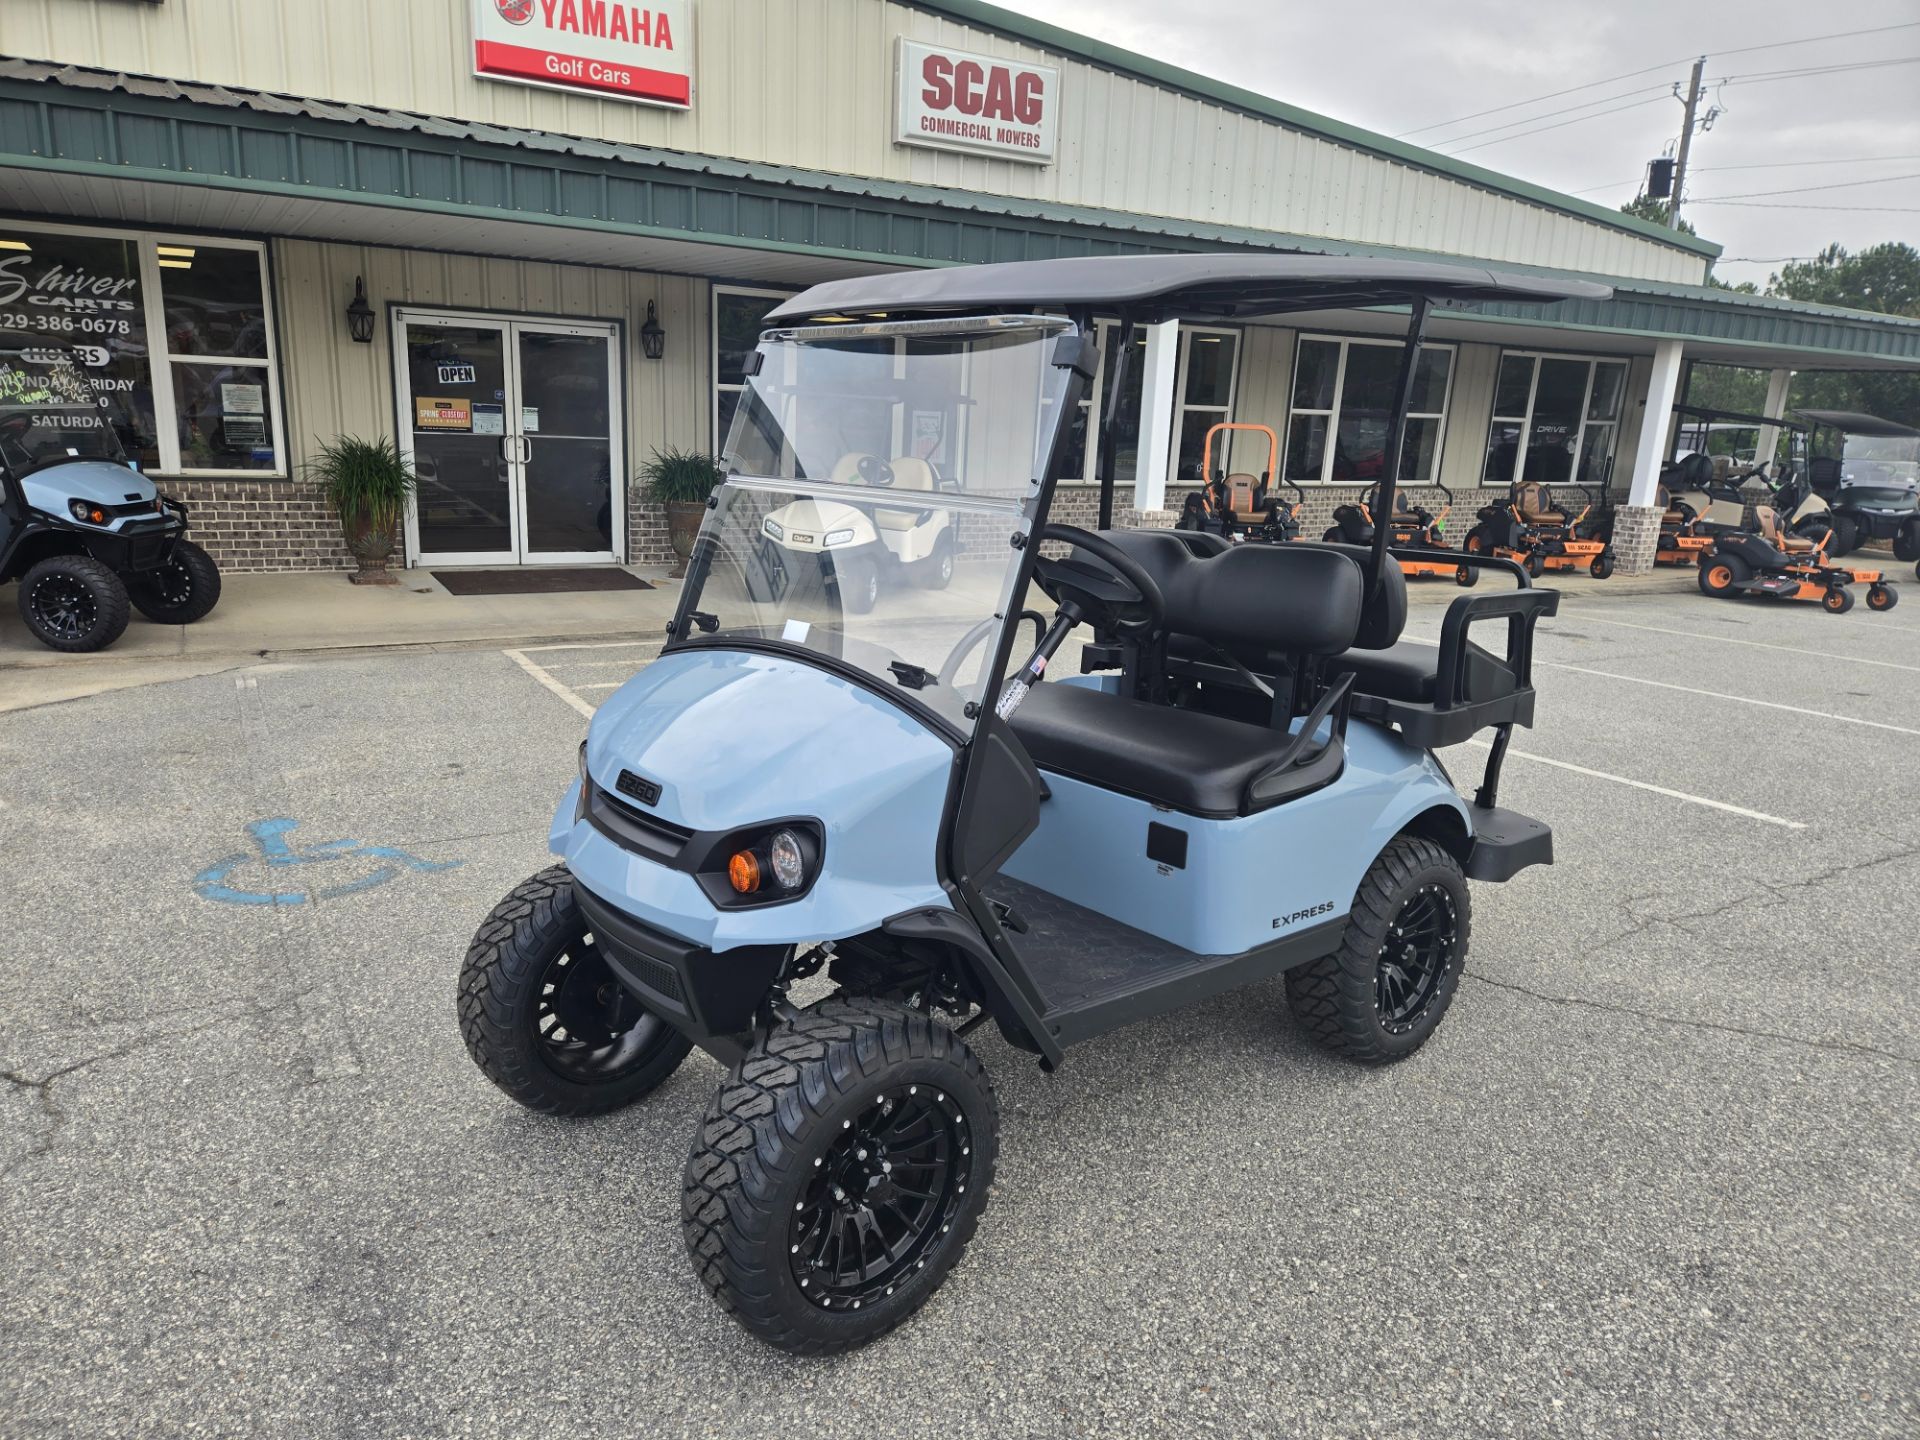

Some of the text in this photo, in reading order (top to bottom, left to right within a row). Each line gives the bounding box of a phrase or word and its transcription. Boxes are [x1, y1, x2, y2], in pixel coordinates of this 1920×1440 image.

[541, 0, 673, 50] YAMAHA
[545, 55, 631, 85] Golf Cars
[922, 54, 1044, 125] SCAG
[921, 115, 1041, 148] COMMERCIAL MOWERS
[28, 295, 135, 311] CARTS
[0, 313, 130, 334] 29-386-0678
[441, 367, 473, 381] OPEN
[1536, 425, 1567, 433] DRIVE
[1272, 900, 1335, 929] EXPRESS
